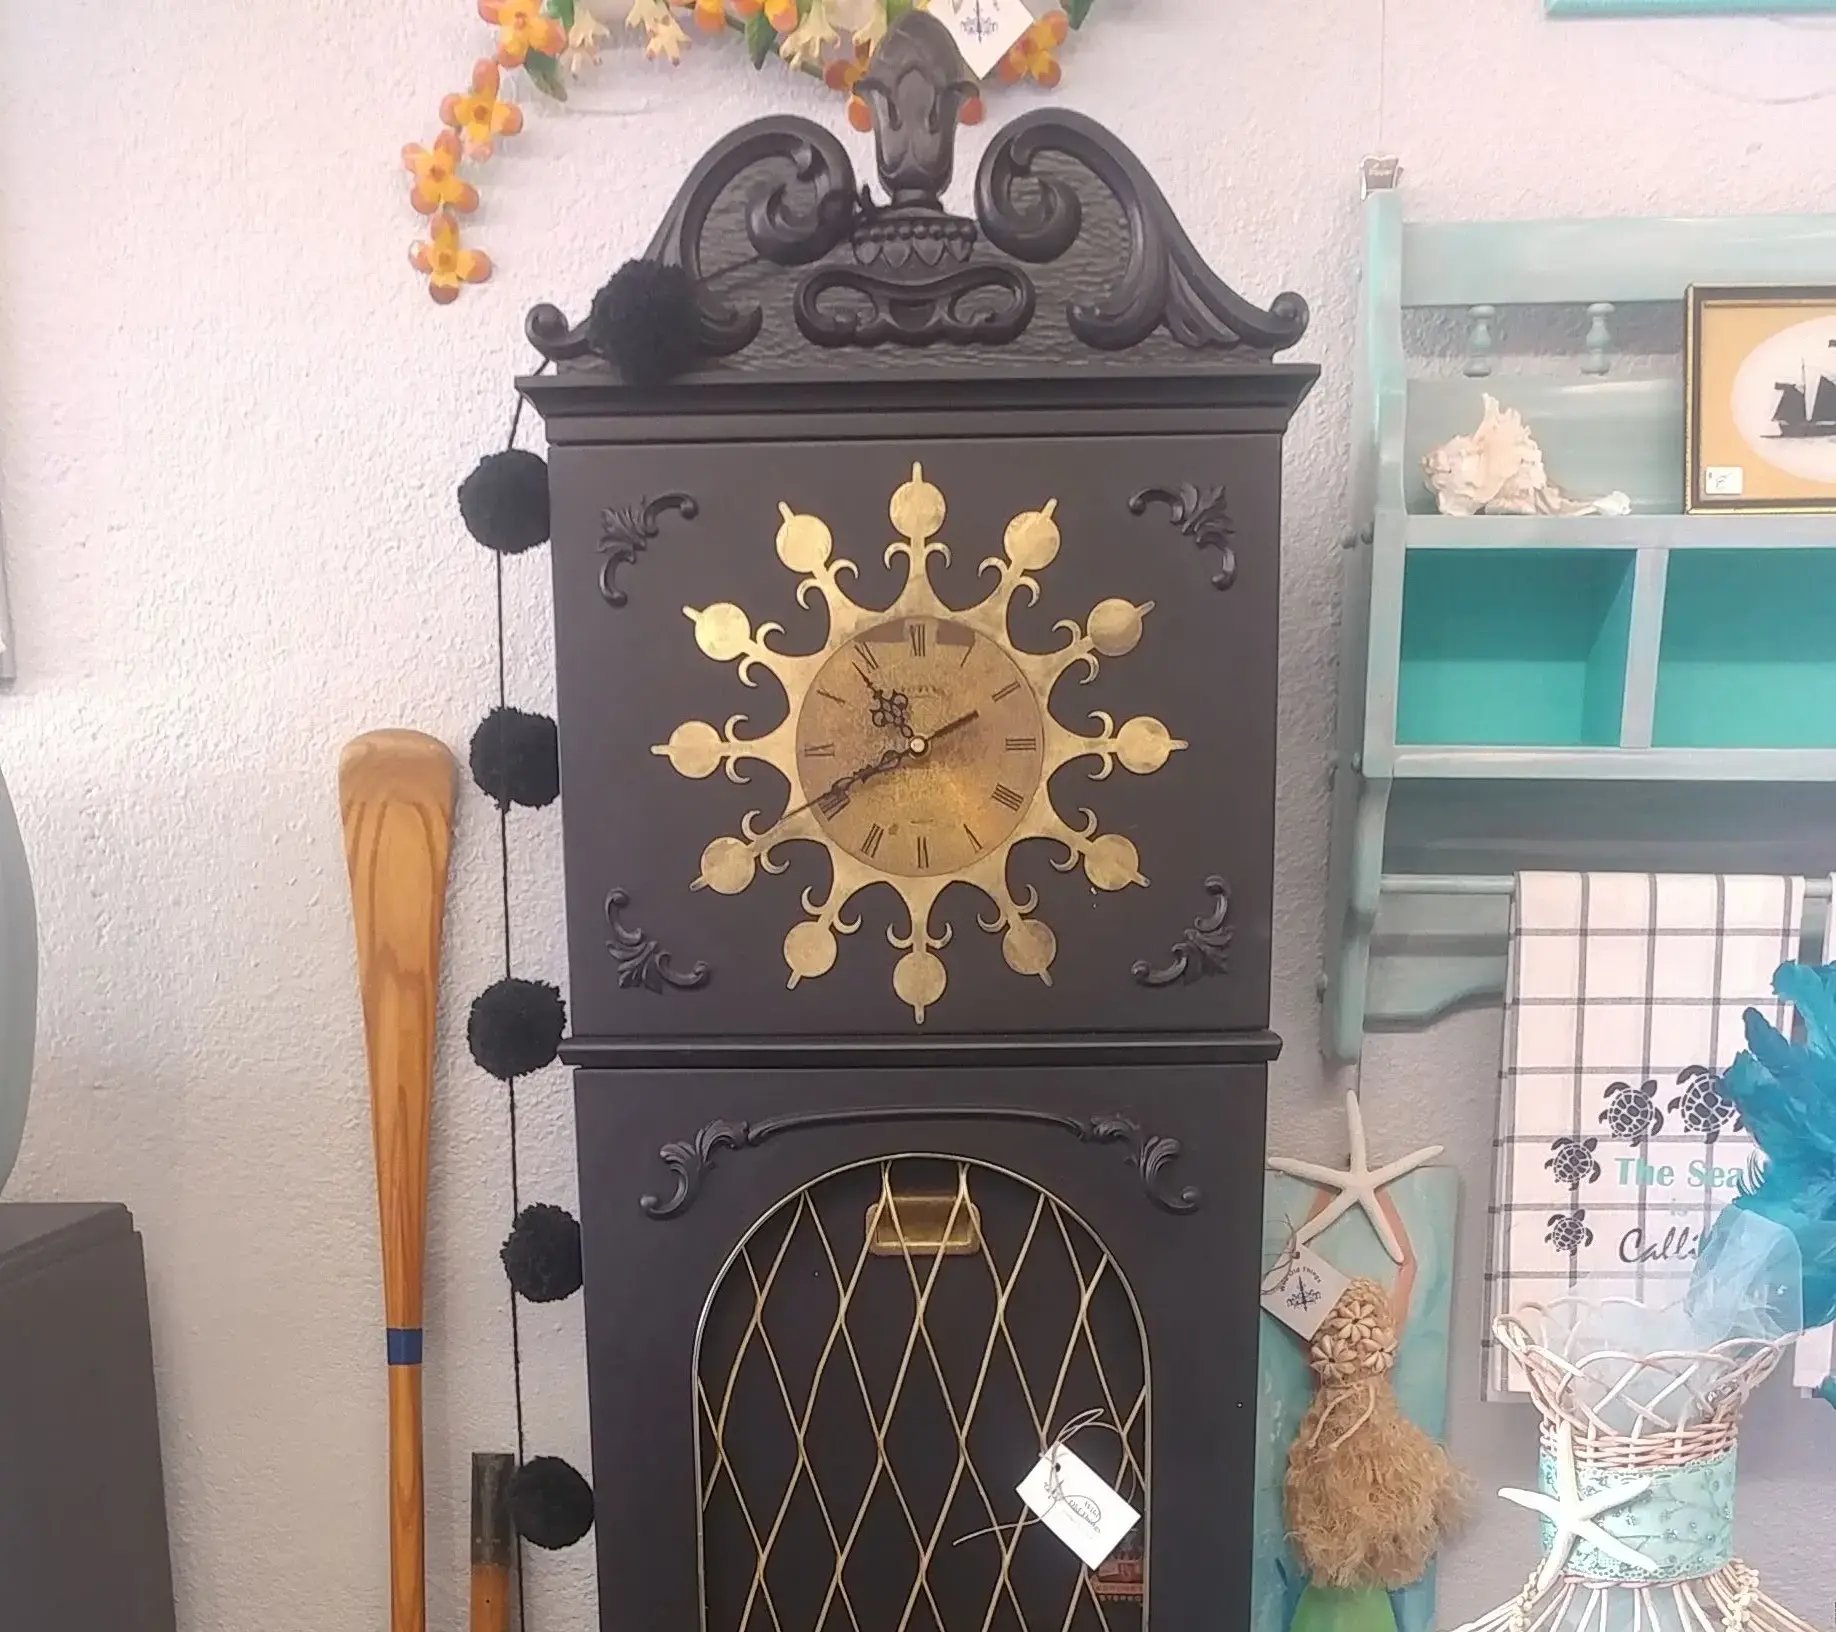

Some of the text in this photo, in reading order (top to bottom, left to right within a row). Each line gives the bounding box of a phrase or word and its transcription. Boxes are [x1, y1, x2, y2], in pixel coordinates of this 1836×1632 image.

[1614, 1157, 1743, 1188] The Sea
[1619, 1226, 1700, 1263] Calli
